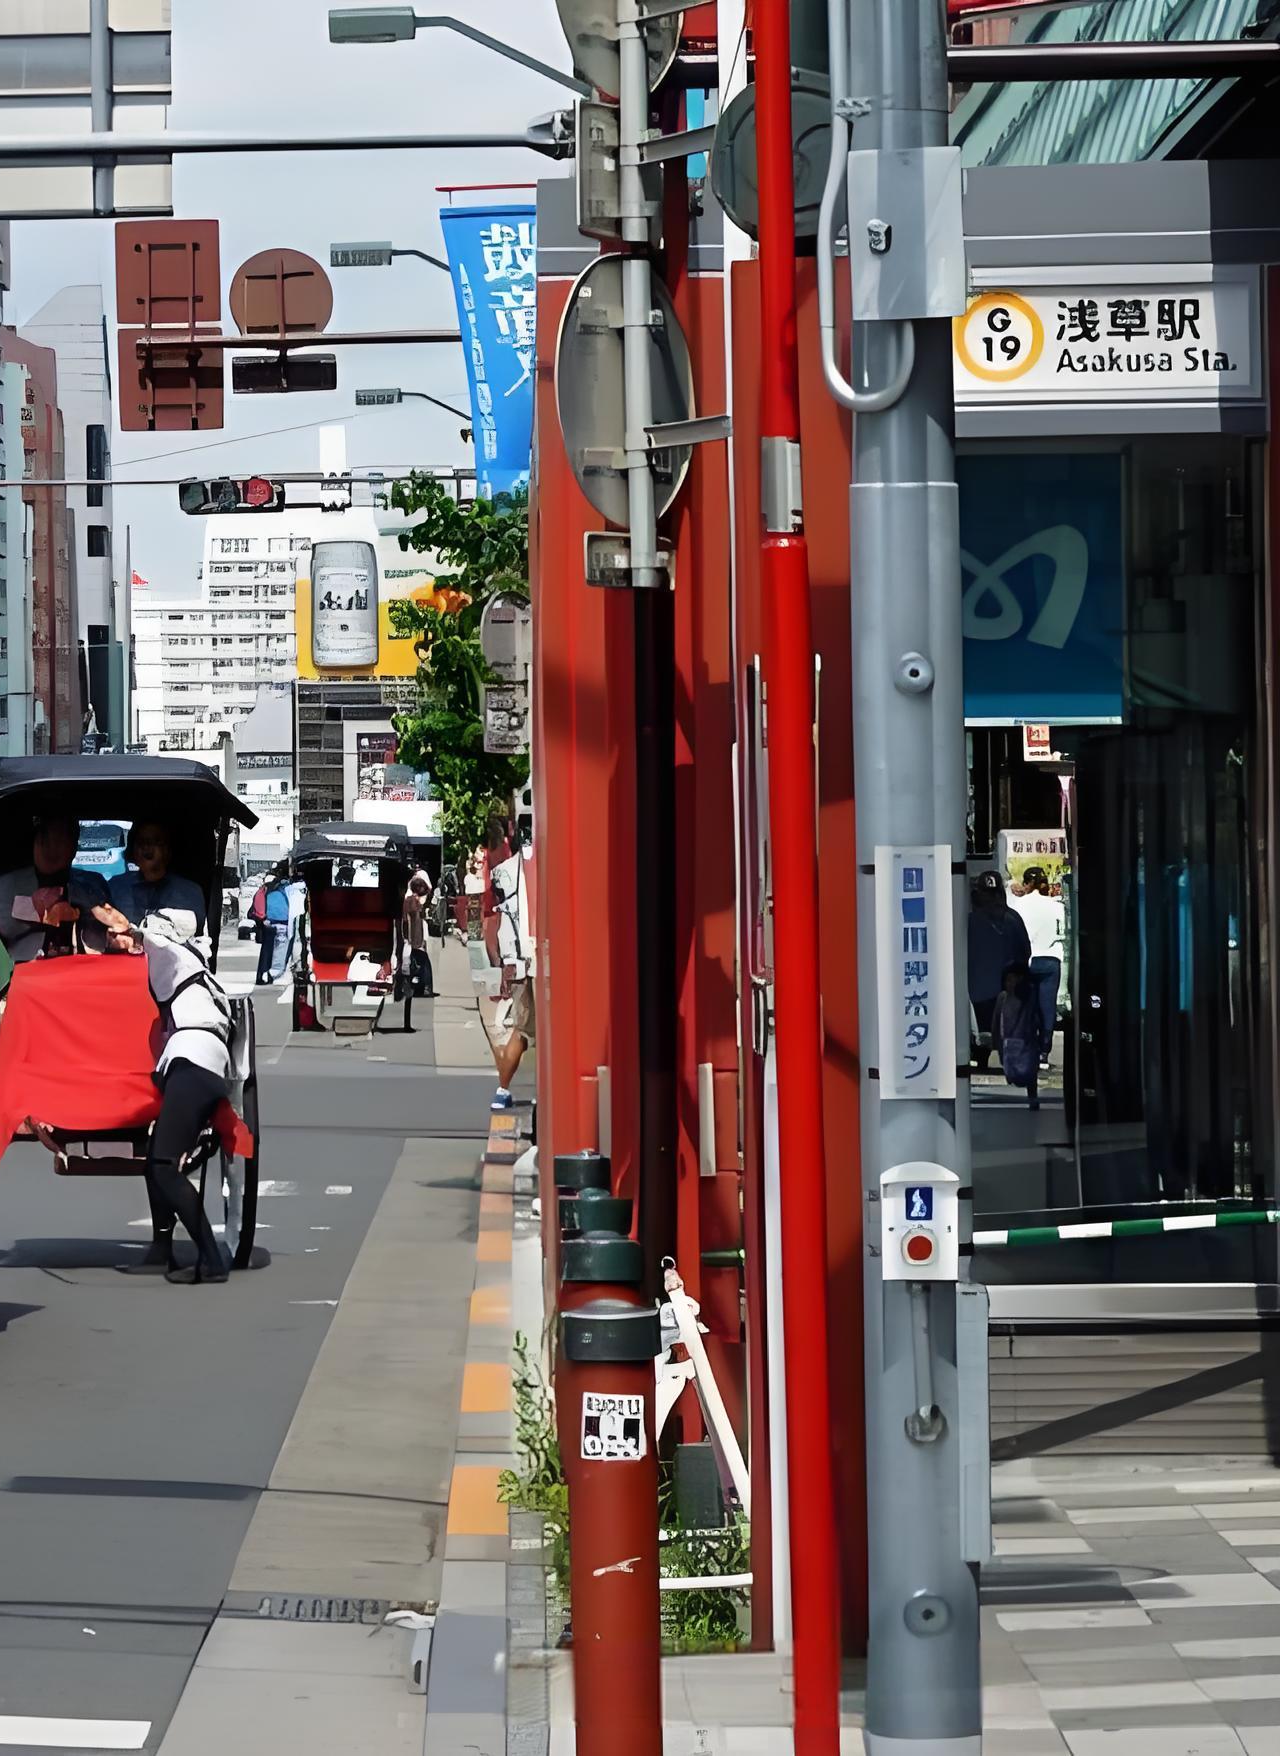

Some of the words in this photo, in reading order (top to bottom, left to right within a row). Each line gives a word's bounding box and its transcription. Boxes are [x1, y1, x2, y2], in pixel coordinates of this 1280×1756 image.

[987, 307, 1012, 333] G
[1056, 299, 1200, 342] 浅草駅
[981, 335, 1022, 362] 19
[1056, 347, 1173, 373] Asakusa
[1183, 347, 1238, 372] Sta.
